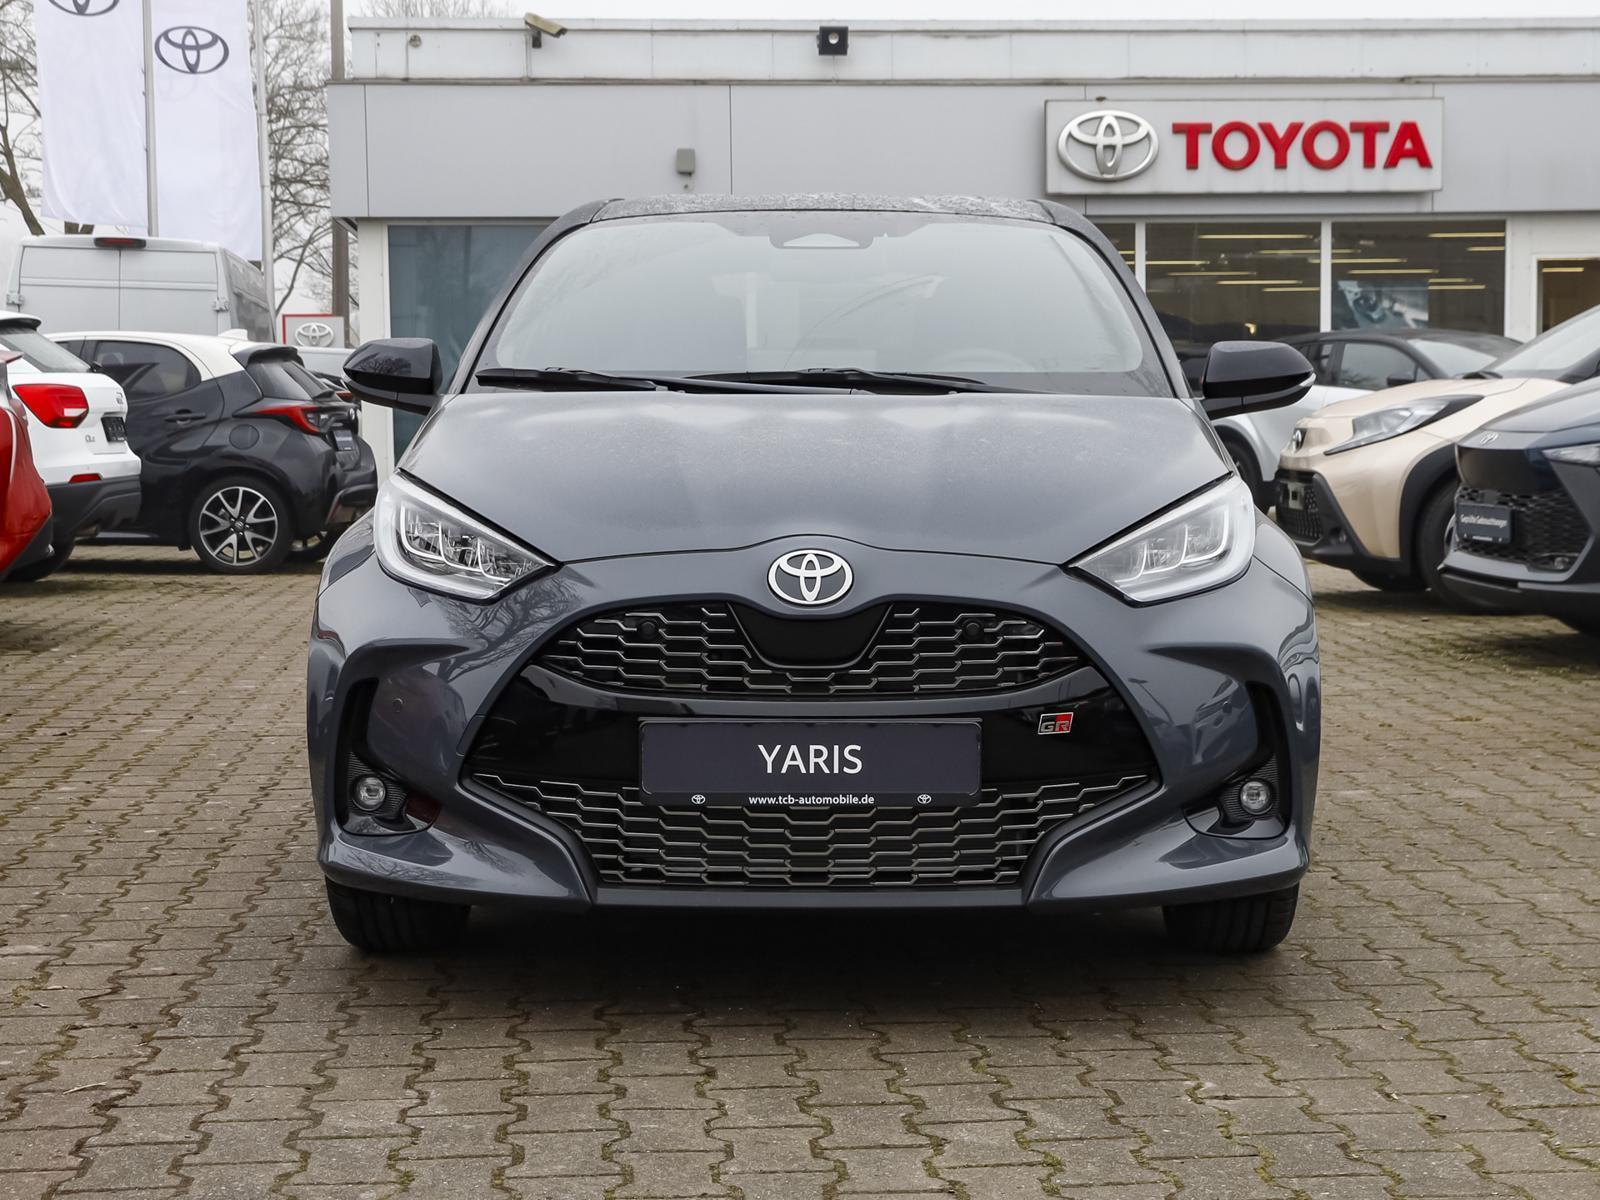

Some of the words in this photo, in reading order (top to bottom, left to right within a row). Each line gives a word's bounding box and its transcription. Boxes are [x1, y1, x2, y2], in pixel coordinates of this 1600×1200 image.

[1172, 120, 1433, 170] TOYOTA
[757, 744, 863, 774] YARIS
[748, 794, 875, 805] www.tcb-automobile.de
